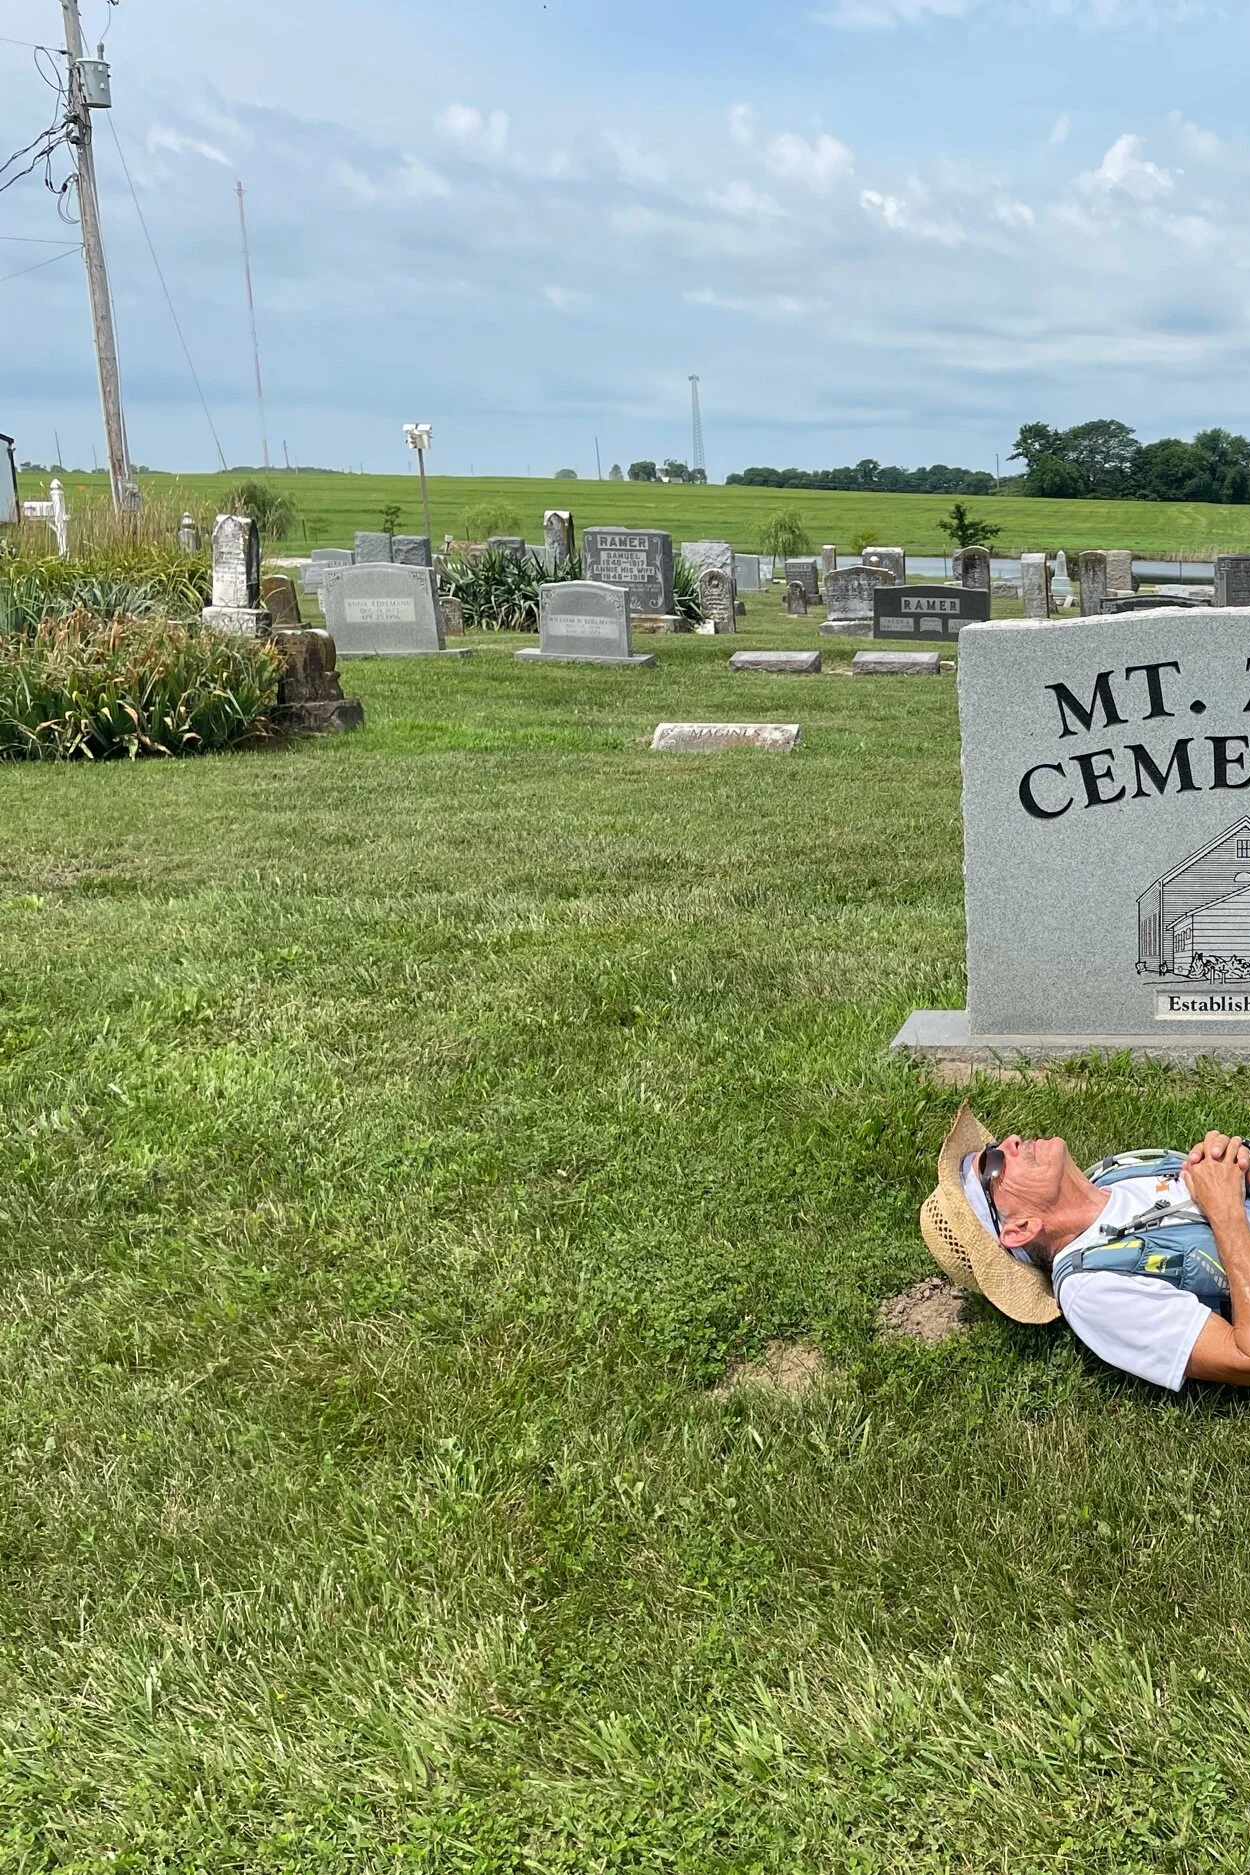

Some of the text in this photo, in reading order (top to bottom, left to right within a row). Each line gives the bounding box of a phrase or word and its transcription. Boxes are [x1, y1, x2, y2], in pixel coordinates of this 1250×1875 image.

[600, 536, 647, 549] RAMER
[606, 552, 640, 560] SAMUEL
[594, 565, 619, 573] ANNIE
[637, 567, 655, 575] WIFE
[903, 599, 958, 611] RAMER
[1044, 660, 1207, 738] MT.
